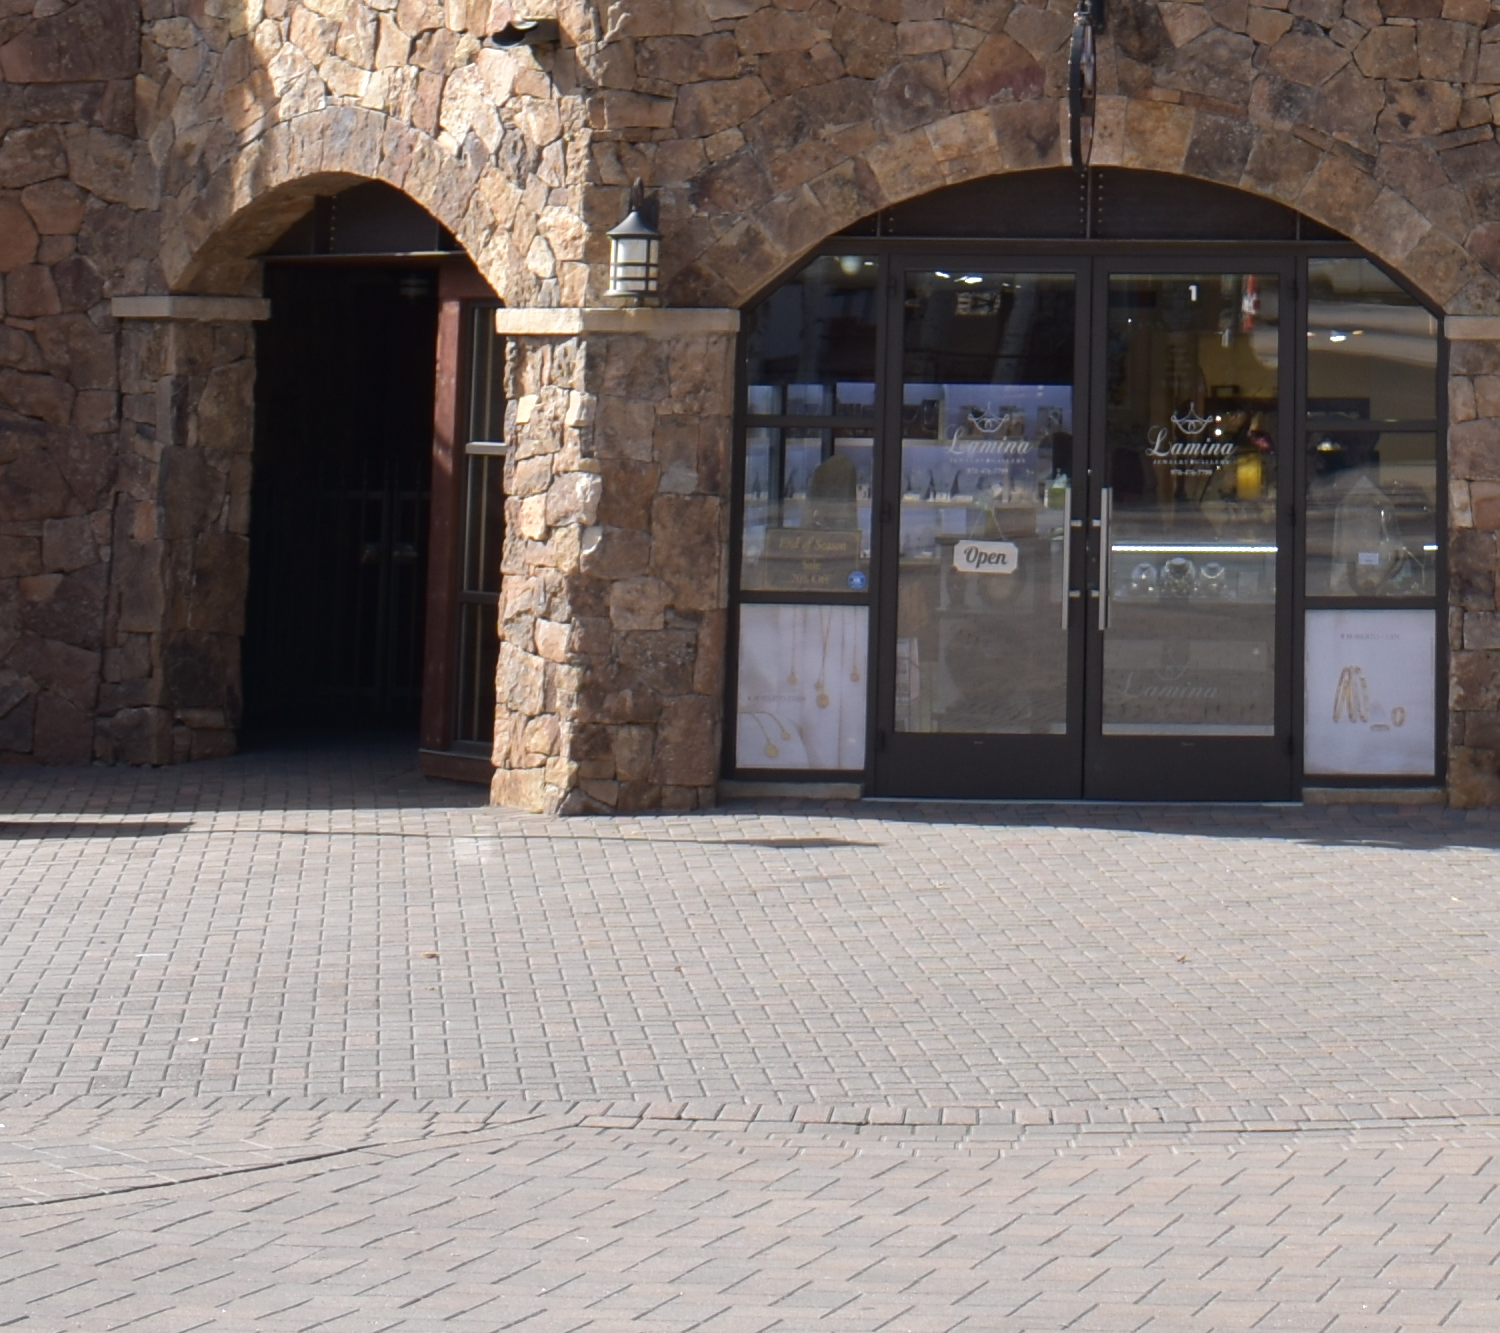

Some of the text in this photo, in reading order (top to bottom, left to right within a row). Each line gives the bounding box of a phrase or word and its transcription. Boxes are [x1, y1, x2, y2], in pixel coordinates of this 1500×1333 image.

[945, 423, 1033, 455] Lamina
[1145, 425, 1238, 456] Lamina
[964, 546, 1007, 568] Open
